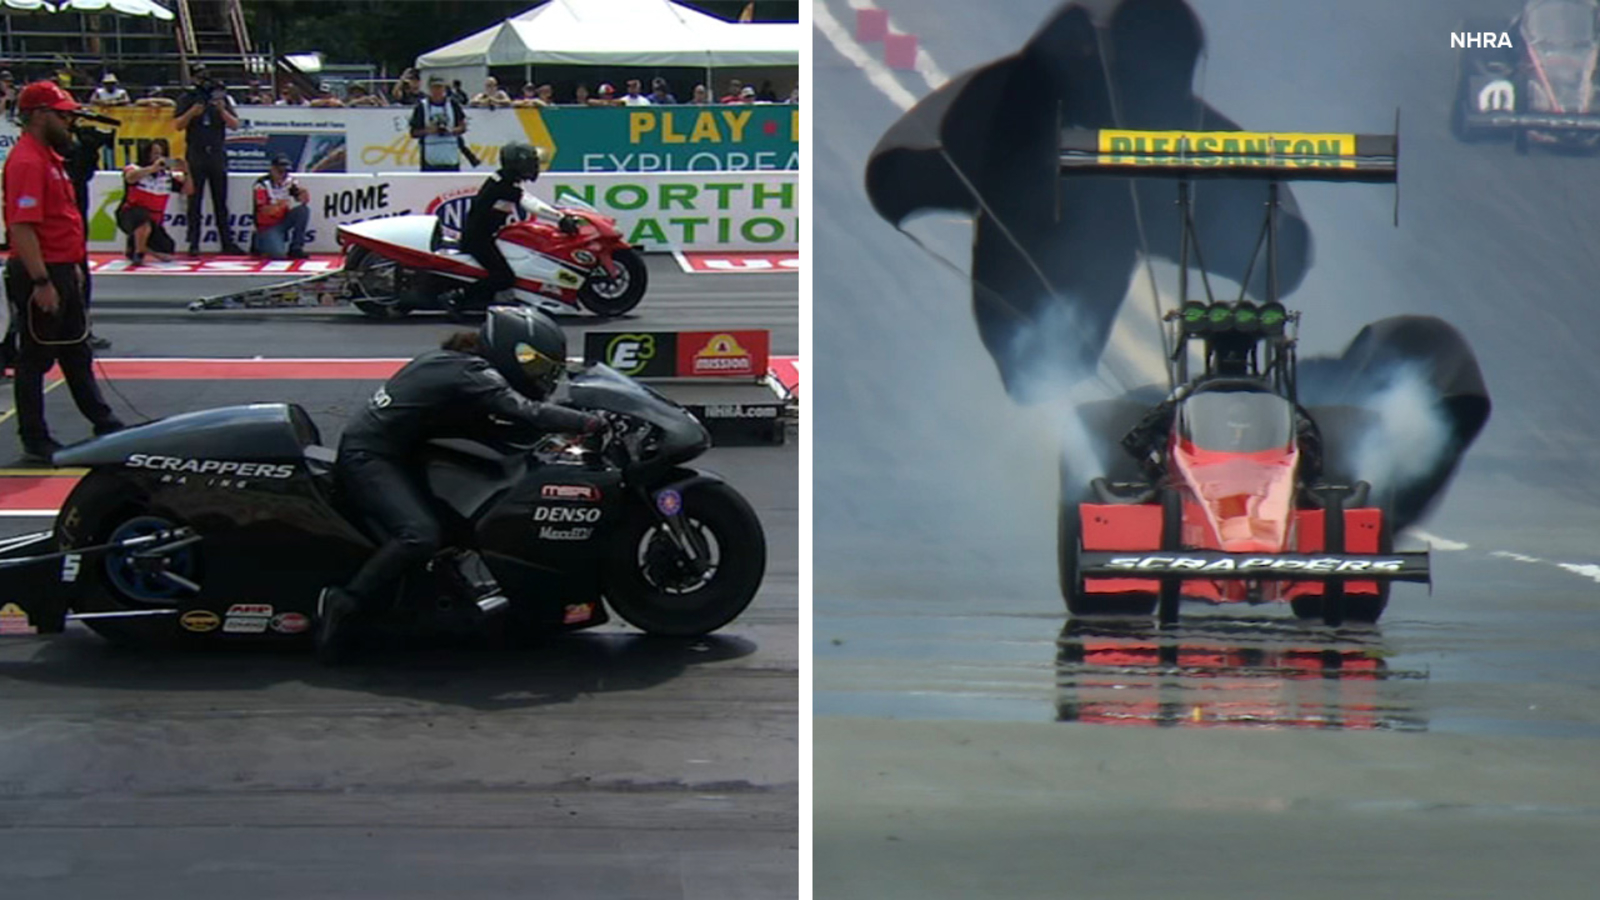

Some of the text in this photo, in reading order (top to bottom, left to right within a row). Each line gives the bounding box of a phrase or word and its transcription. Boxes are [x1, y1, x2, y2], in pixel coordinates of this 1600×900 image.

[629, 111, 752, 143] PLAY
[1109, 136, 1342, 166] PLEASANTON
[323, 183, 389, 219] HOME
[163, 214, 255, 226] PAIIC
[627, 216, 799, 244] ATIO
[126, 454, 295, 479] SCRAPPERS
[161, 474, 247, 489] RAING
[533, 506, 602, 523] DENSO
[1105, 555, 1404, 572] SCRAPPERS
